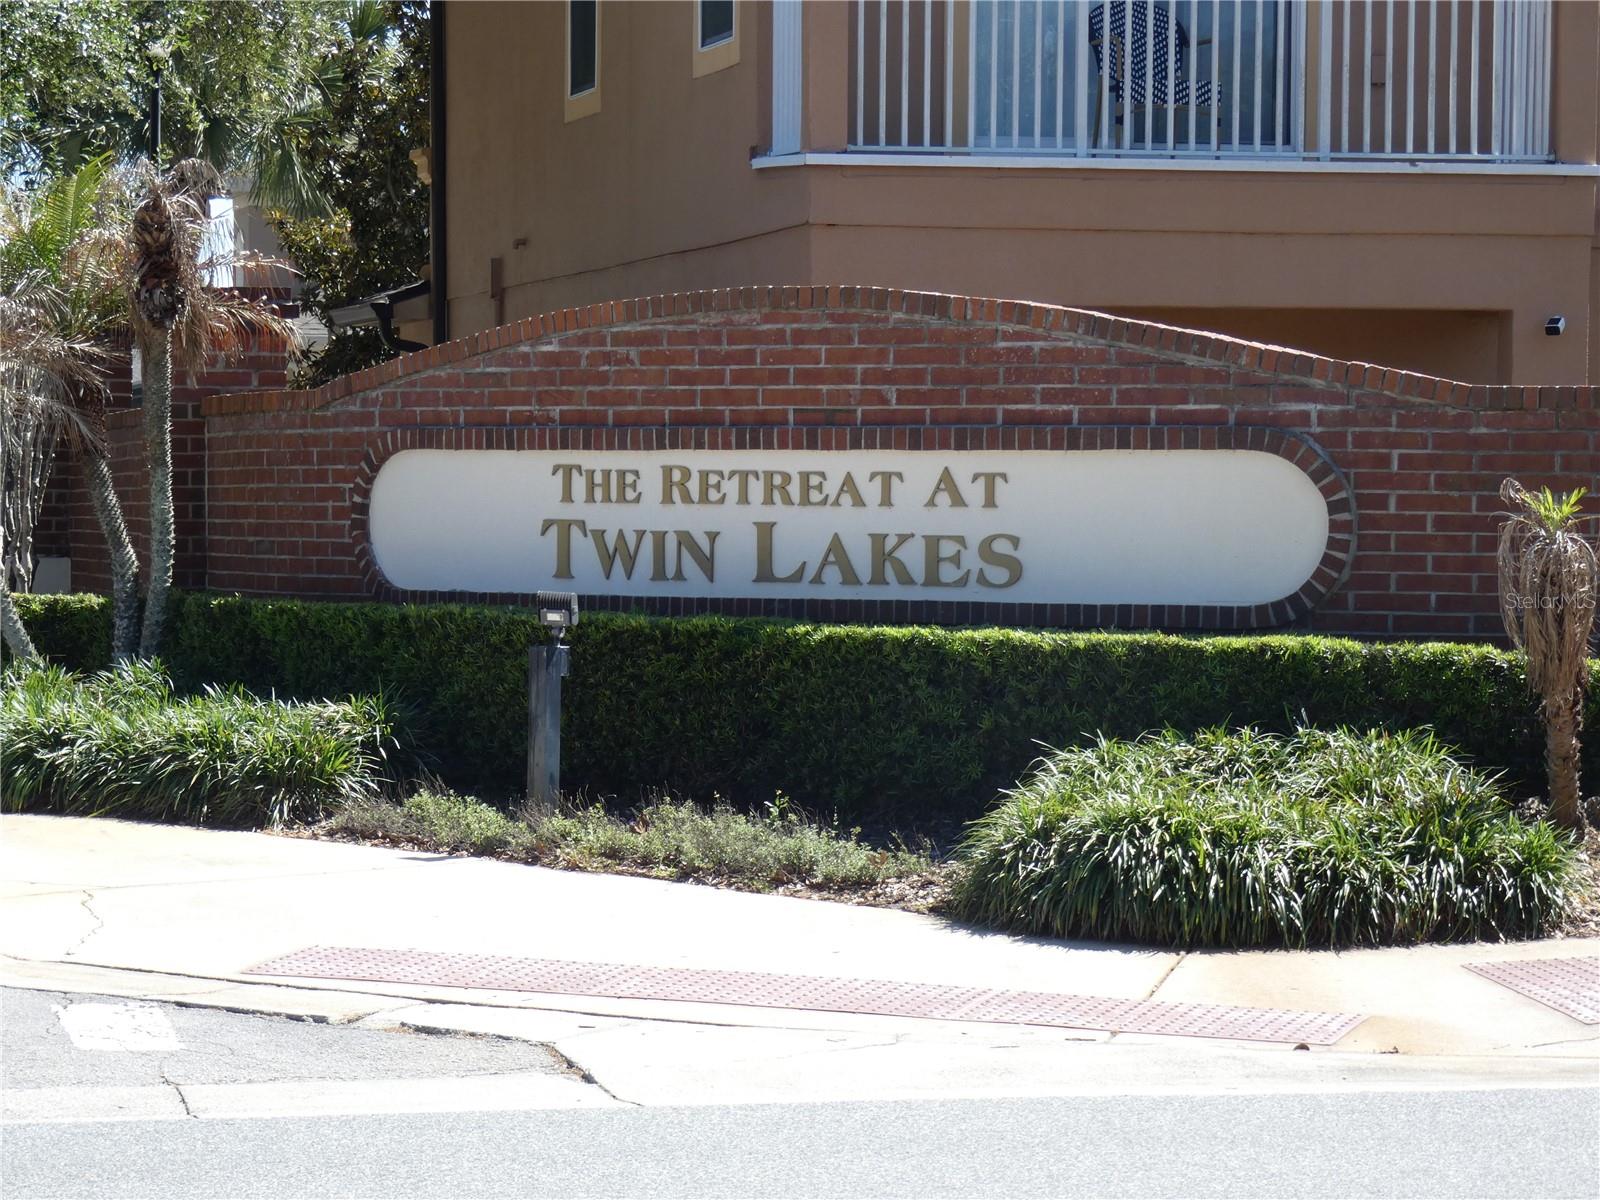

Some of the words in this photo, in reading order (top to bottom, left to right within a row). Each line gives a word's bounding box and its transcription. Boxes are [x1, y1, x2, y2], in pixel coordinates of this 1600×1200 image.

[552, 464, 642, 504] THE
[660, 465, 904, 508] RETREAT
[924, 466, 1008, 508] AT
[540, 518, 721, 583] TWIN
[752, 521, 1024, 588] LAKES
